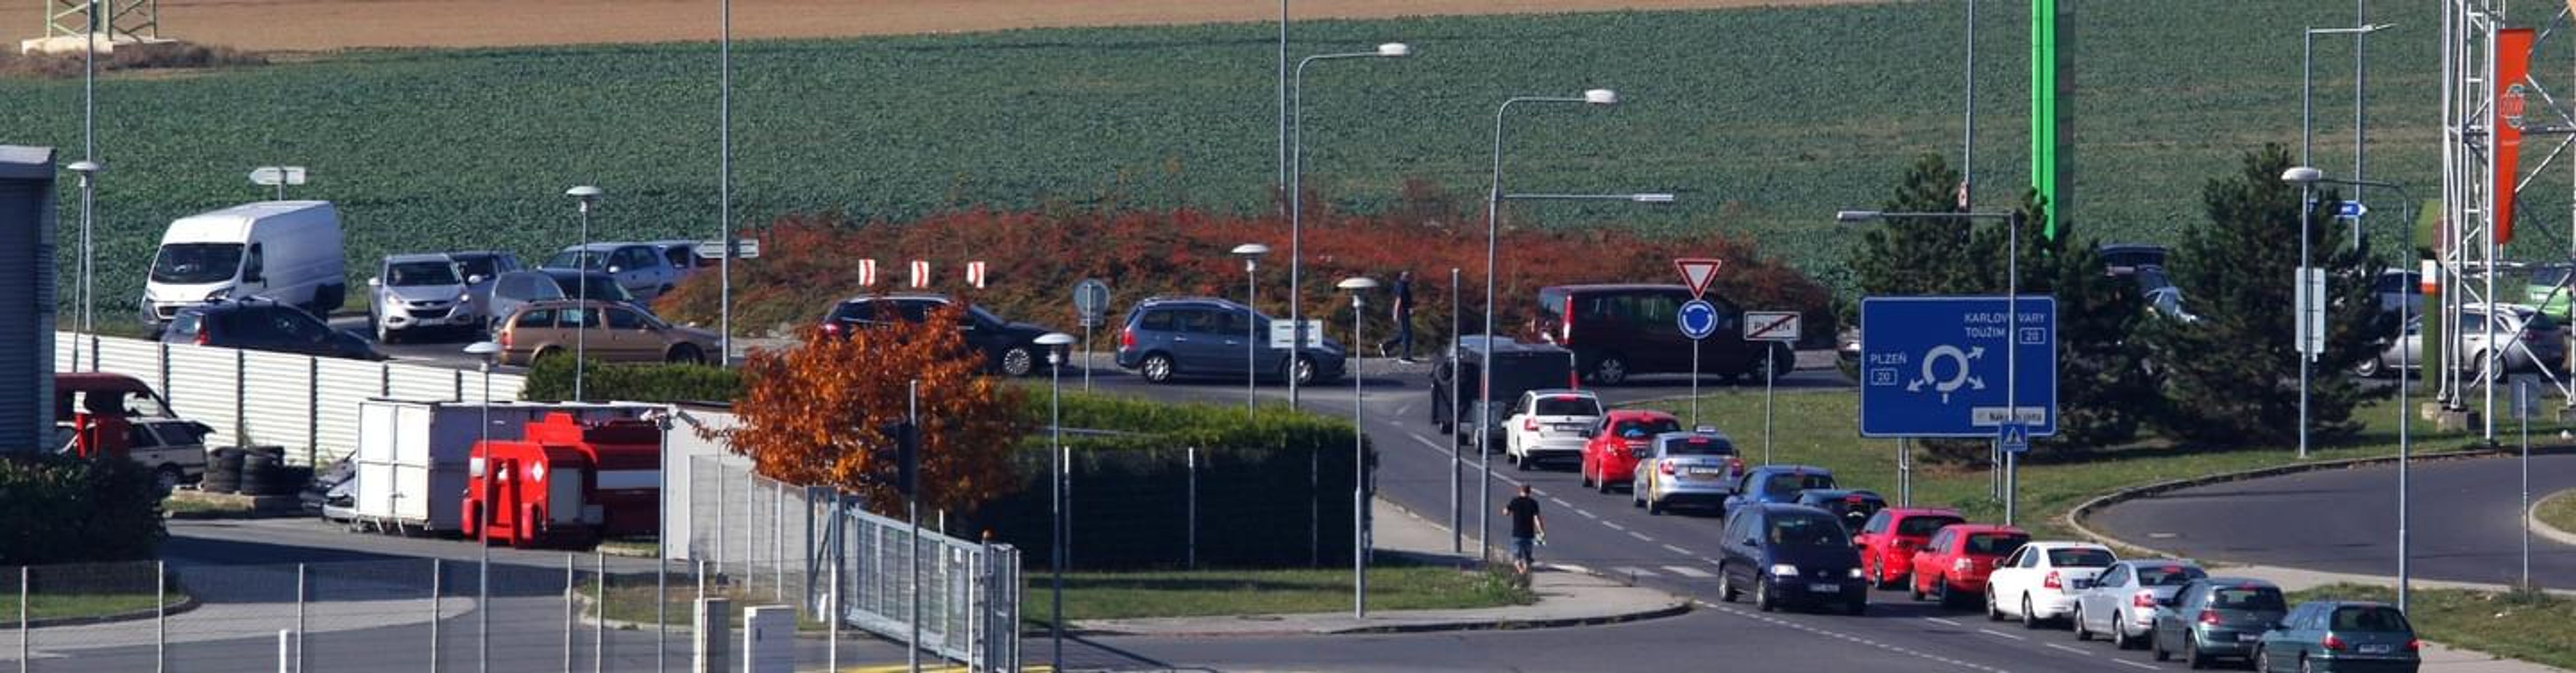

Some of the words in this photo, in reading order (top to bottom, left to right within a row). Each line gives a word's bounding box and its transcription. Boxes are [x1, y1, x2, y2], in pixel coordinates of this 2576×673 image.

[1964, 313, 2013, 323] KARLOV
[2018, 313, 2046, 323] VARY
[1870, 351, 1906, 364] PLZEŇ
[1878, 372, 1890, 382] 20
